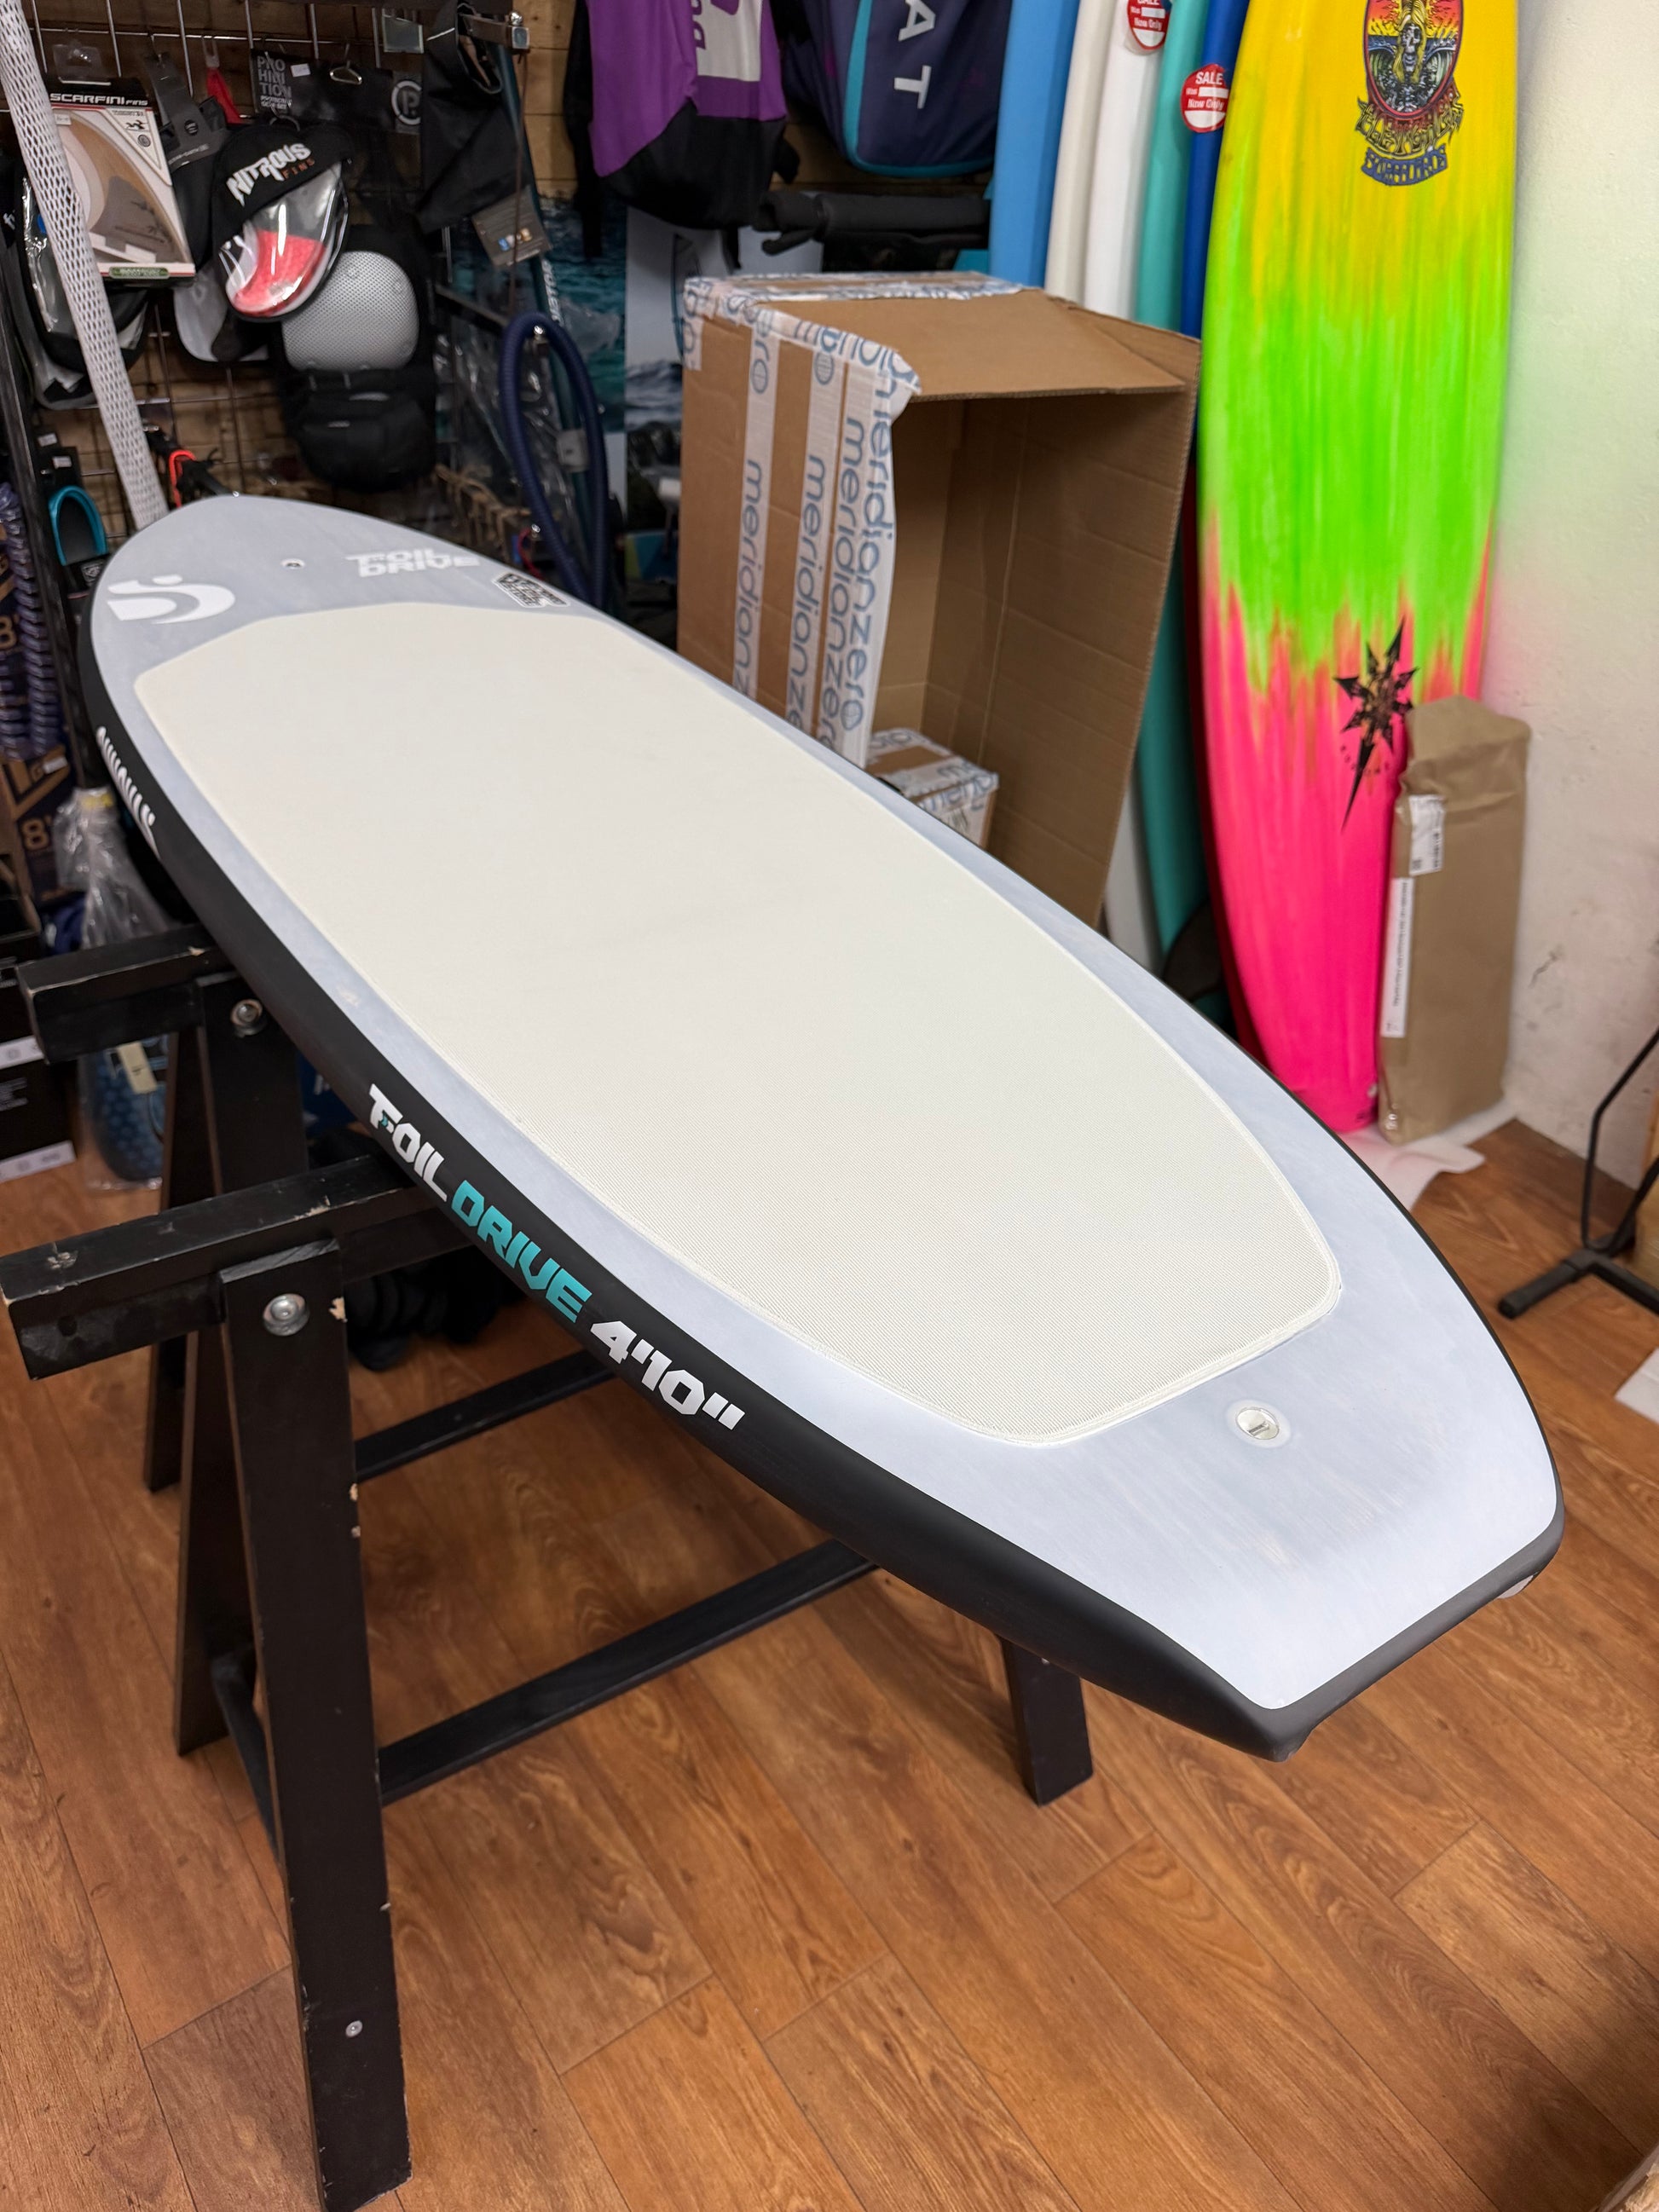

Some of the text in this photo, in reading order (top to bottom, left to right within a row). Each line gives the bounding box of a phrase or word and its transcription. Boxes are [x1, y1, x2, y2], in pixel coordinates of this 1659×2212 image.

[1195, 72, 1223, 85] SALE
[49, 93, 125, 105] SCARFINI
[226, 142, 312, 207] NITROUS
[281, 158, 315, 181] FINS
[369, 1083, 745, 1430] FOIL DRIVE 4'10"
